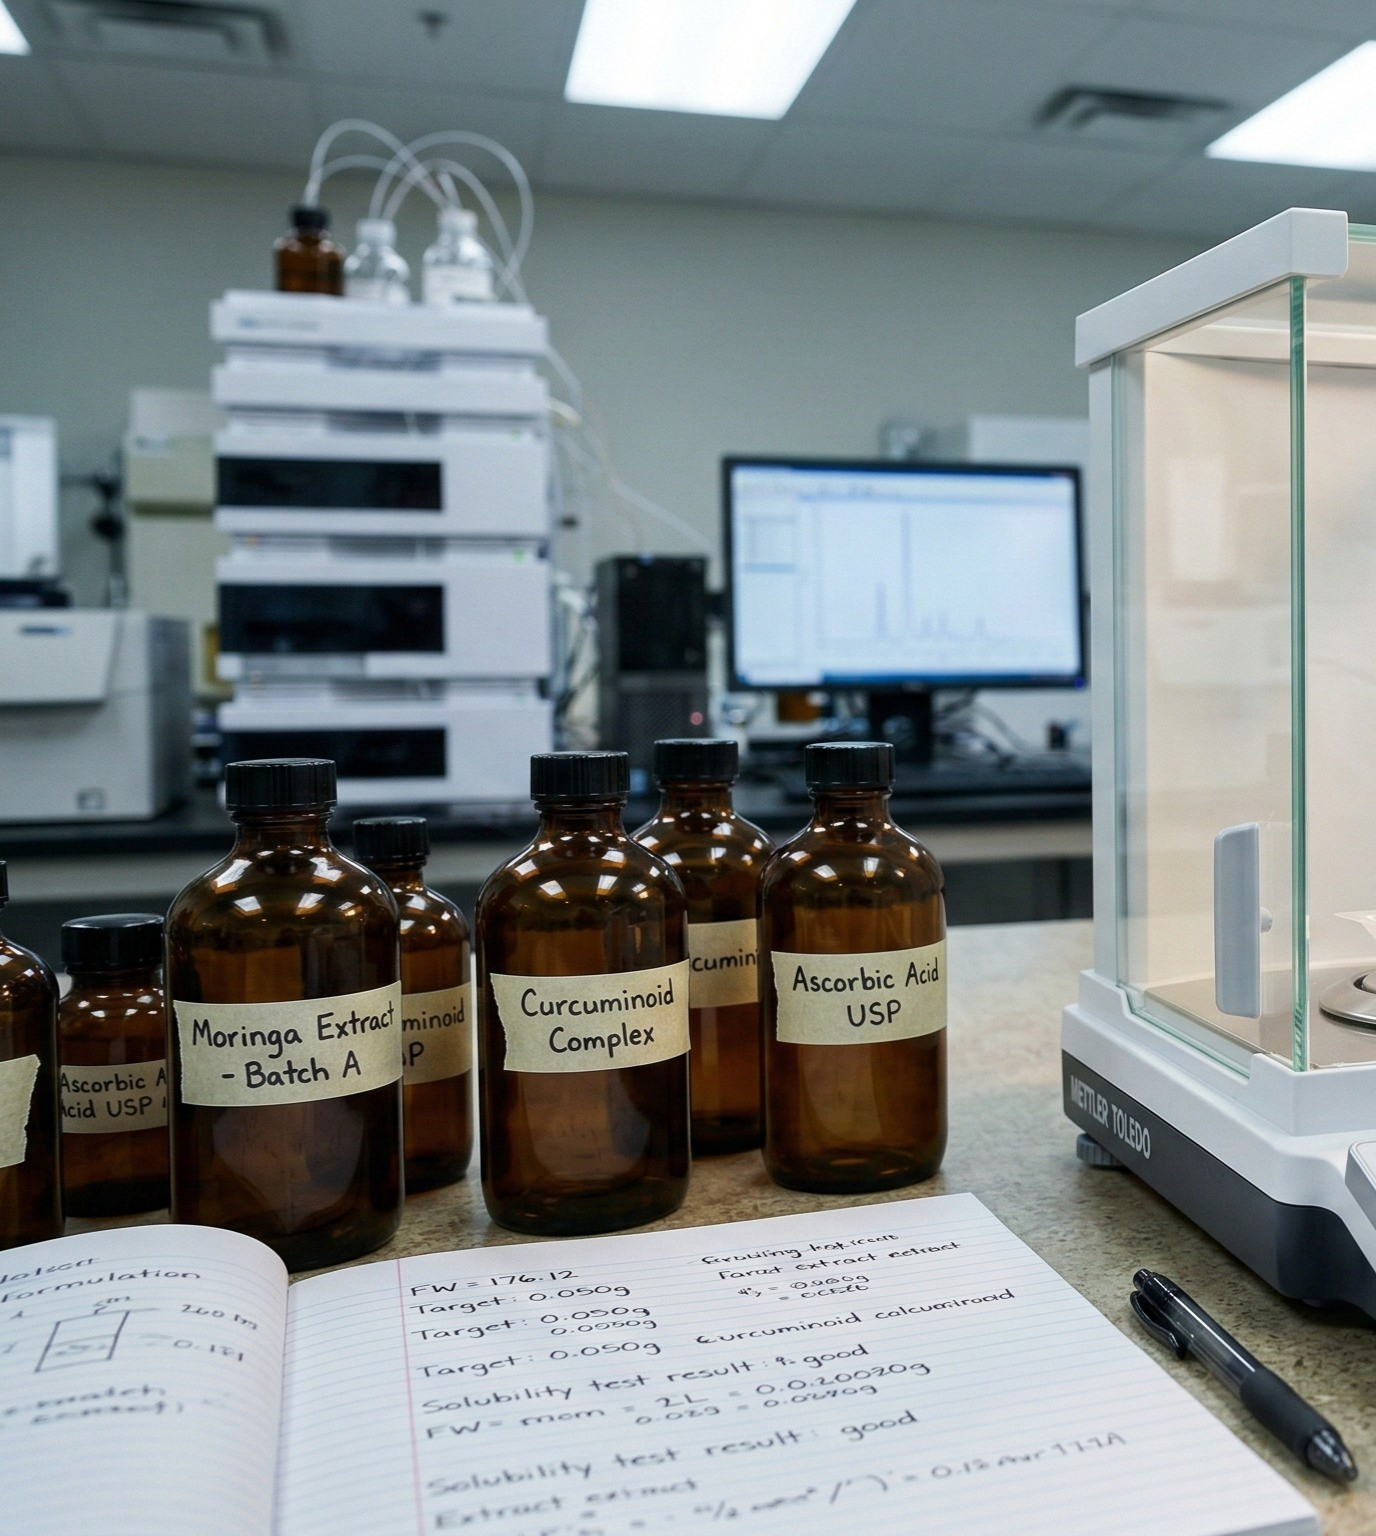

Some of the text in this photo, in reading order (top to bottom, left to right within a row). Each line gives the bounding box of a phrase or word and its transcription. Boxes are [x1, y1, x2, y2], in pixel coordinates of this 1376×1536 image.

[691, 948, 758, 973] cumin
[792, 956, 940, 993] Ascorbic Acid
[520, 977, 675, 1017] Curcuminoid
[846, 999, 902, 1028] USP
[192, 1000, 395, 1060] Moringa Extract
[549, 1022, 655, 1059] Complex
[60, 1072, 147, 1094] Ascorbic
[244, 1056, 330, 1089] Batch
[342, 1050, 362, 1079] A
[106, 1095, 153, 1118] USP
[1070, 1075, 1151, 1160] METTLER TOLEDO
[410, 1282, 458, 1297] FW
[490, 1270, 579, 1287] 176.12
[528, 1284, 631, 1303] 0.050g
[540, 1306, 651, 1325] 0.050g
[549, 1341, 662, 1362] 0.050g
[422, 1385, 573, 1415] Solubility
[588, 1373, 651, 1393] test
[803, 1343, 869, 1370] good
[425, 1420, 481, 1440] FW
[425, 1460, 593, 1498] Solubility
[612, 1447, 680, 1469] test
[840, 1409, 918, 1442] good
